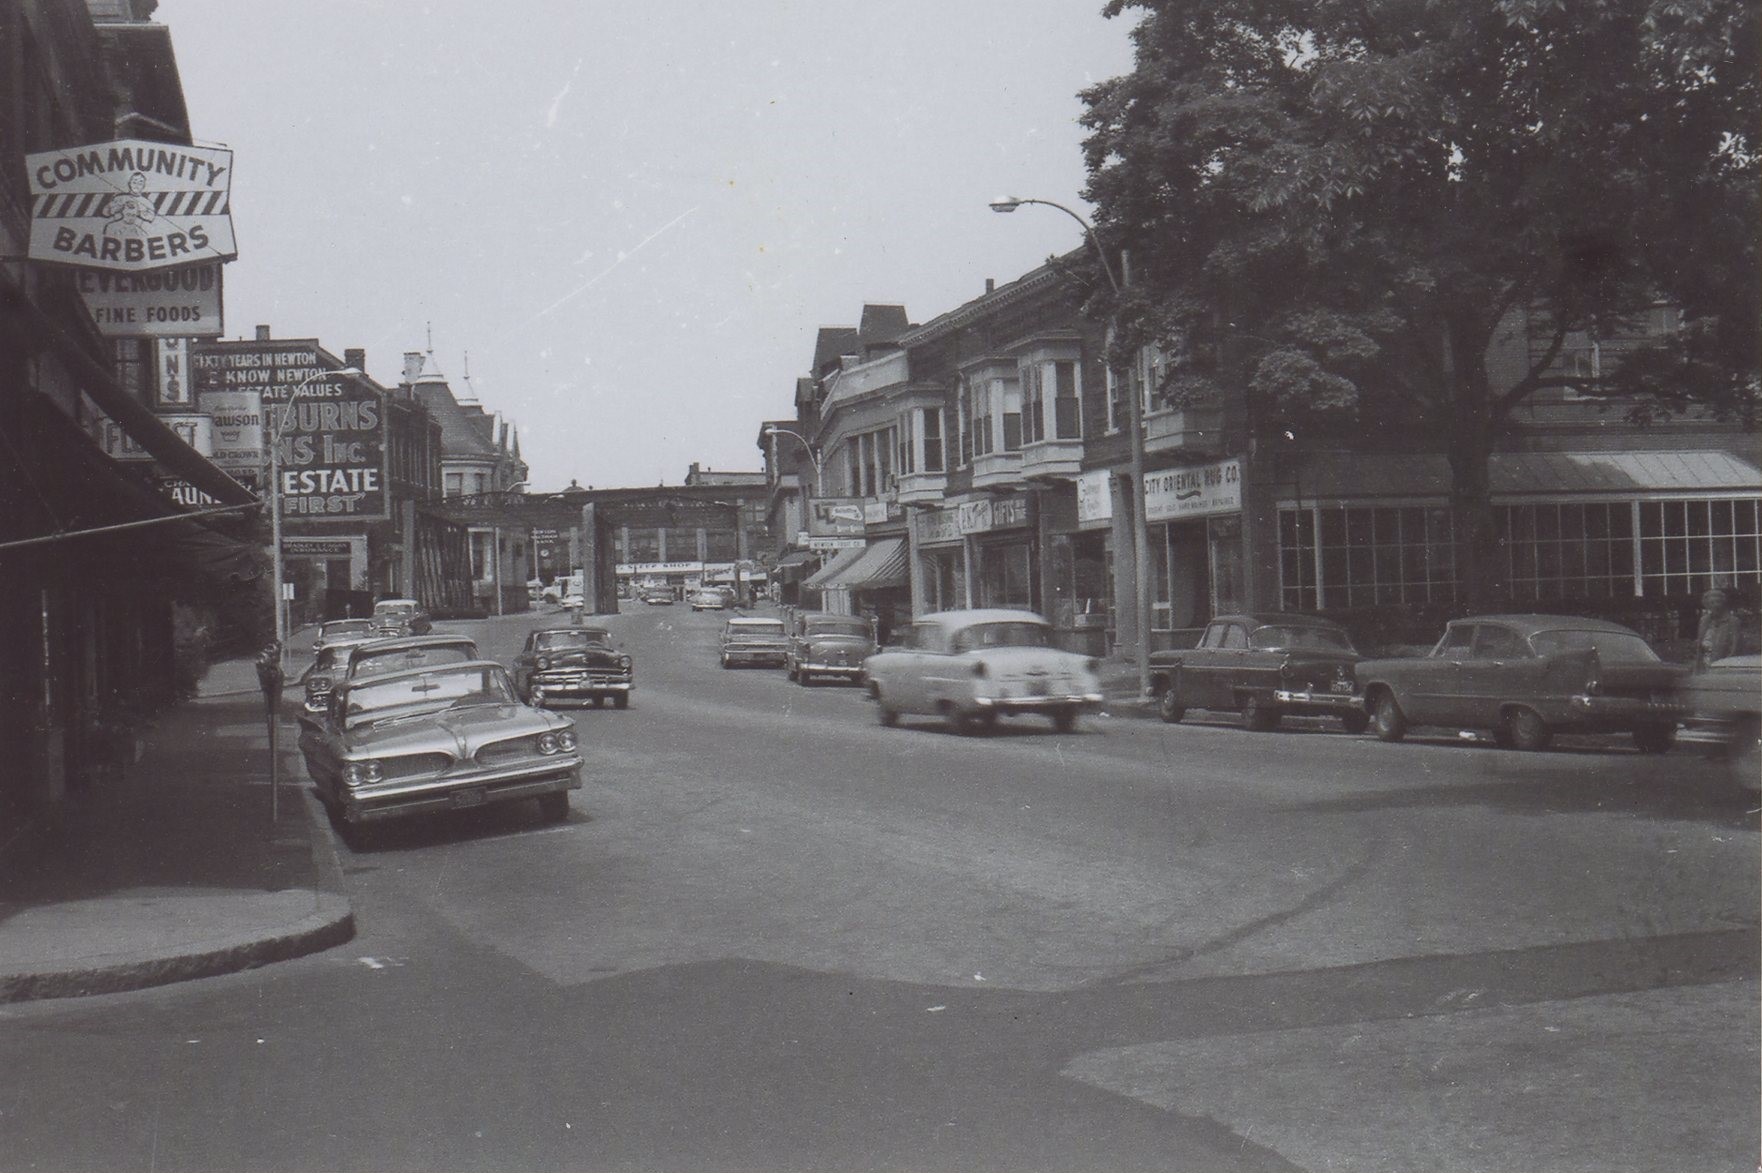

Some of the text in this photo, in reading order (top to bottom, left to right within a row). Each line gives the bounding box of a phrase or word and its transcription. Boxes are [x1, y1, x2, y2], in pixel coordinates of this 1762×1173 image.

[36, 147, 226, 190] COMMUNITY
[53, 225, 208, 262] BARBERS
[95, 305, 200, 323] FINE FOODS
[229, 354, 261, 368] YEARS
[262, 353, 272, 367] IN
[274, 351, 316, 366] NEWTON
[226, 370, 270, 384] KNOW
[276, 367, 326, 382] NEWTON
[292, 383, 342, 398] VALUES
[213, 414, 259, 428] awson
[284, 469, 379, 494] ESTATE
[1163, 472, 1200, 492] ORIENTAL
[1203, 467, 1222, 488] RUG
